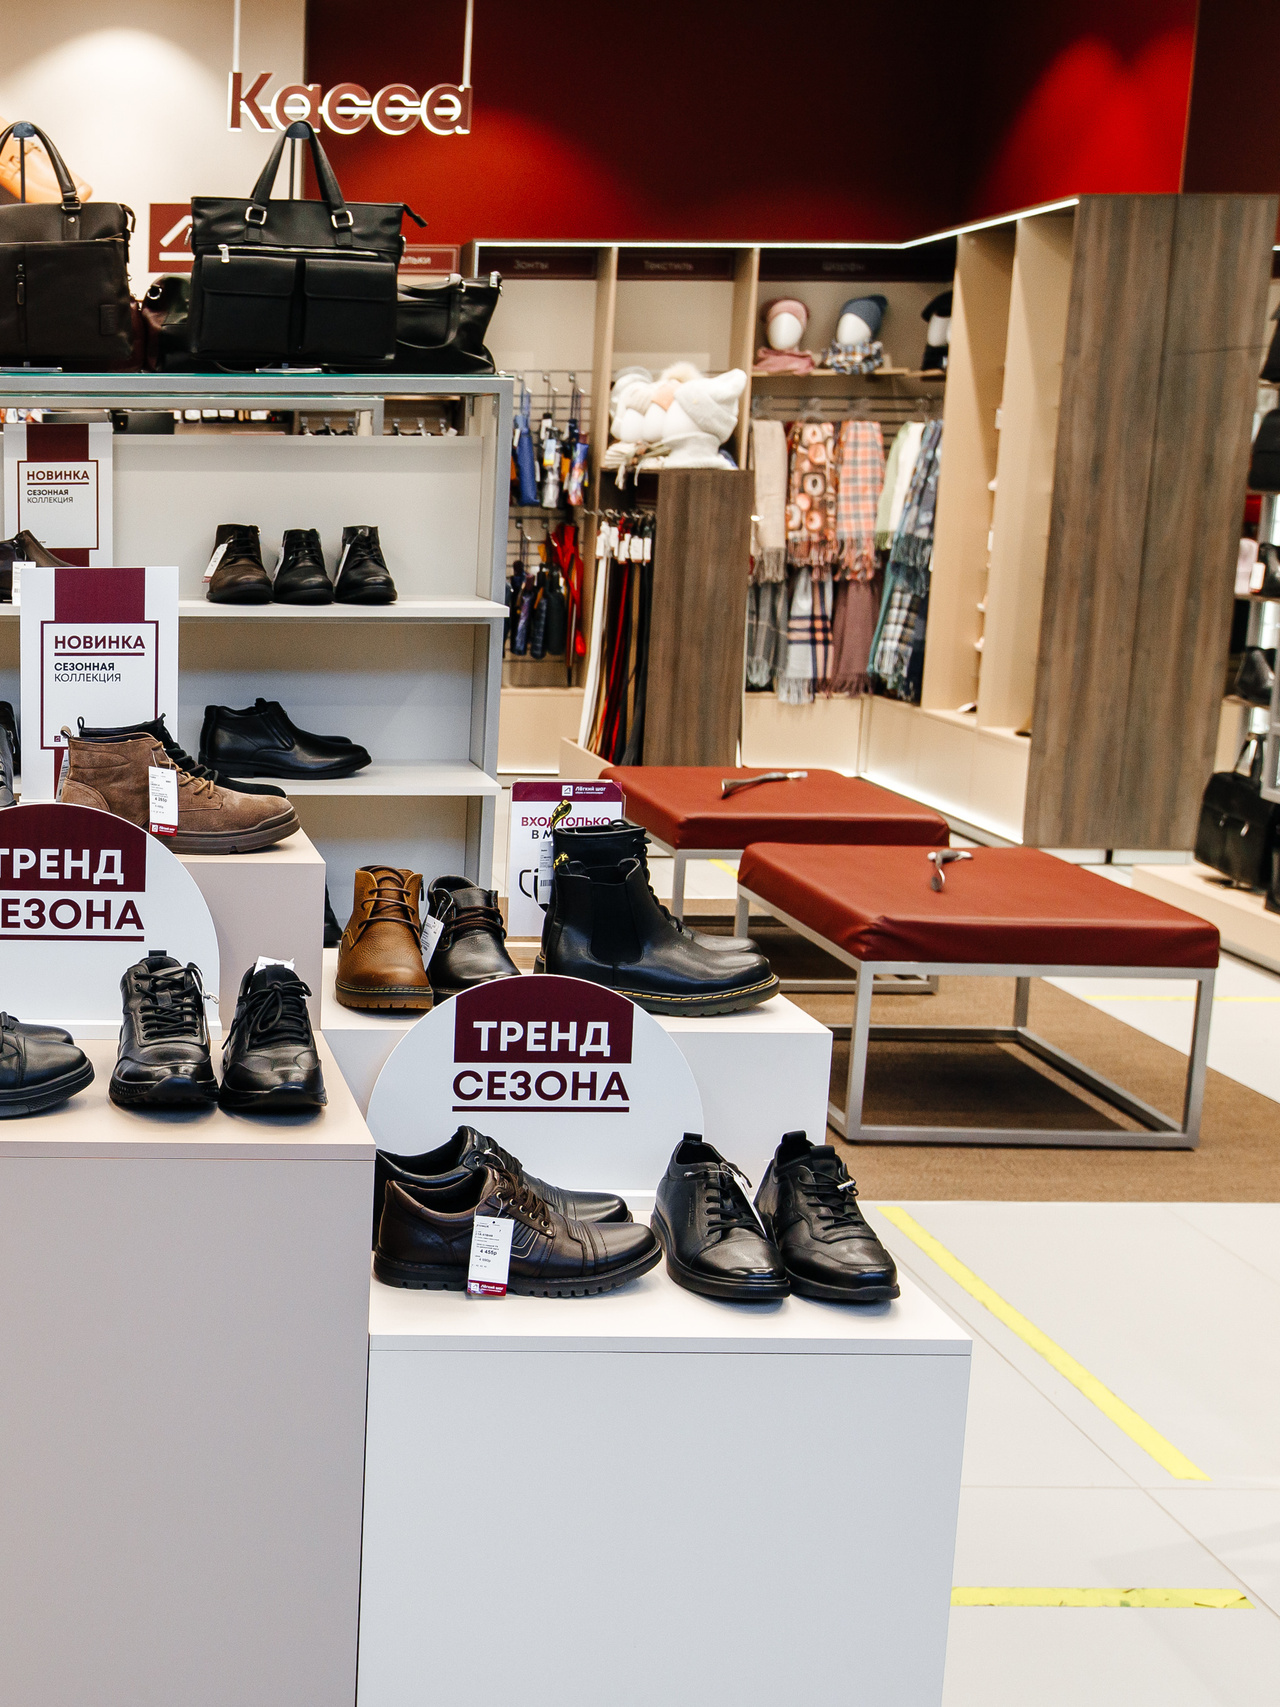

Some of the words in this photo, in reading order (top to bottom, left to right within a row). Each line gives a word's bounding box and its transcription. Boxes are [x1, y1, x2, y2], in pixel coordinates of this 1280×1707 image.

[228, 71, 472, 135] Касса
[26, 470, 90, 482] НОВИНКА
[26, 496, 74, 505] КОЛЛЕКЦИЯ
[54, 635, 146, 650] НОВИНКА
[54, 662, 115, 671] СЕЗОННАЯ
[54, 673, 121, 684] КОЛЛЕКЦИЯ
[560, 816, 612, 827] ТОЛЬКО
[532, 829, 540, 840] В
[473, 1021, 611, 1057] ТРЕНД
[452, 1070, 630, 1101] СЕЗОНА
